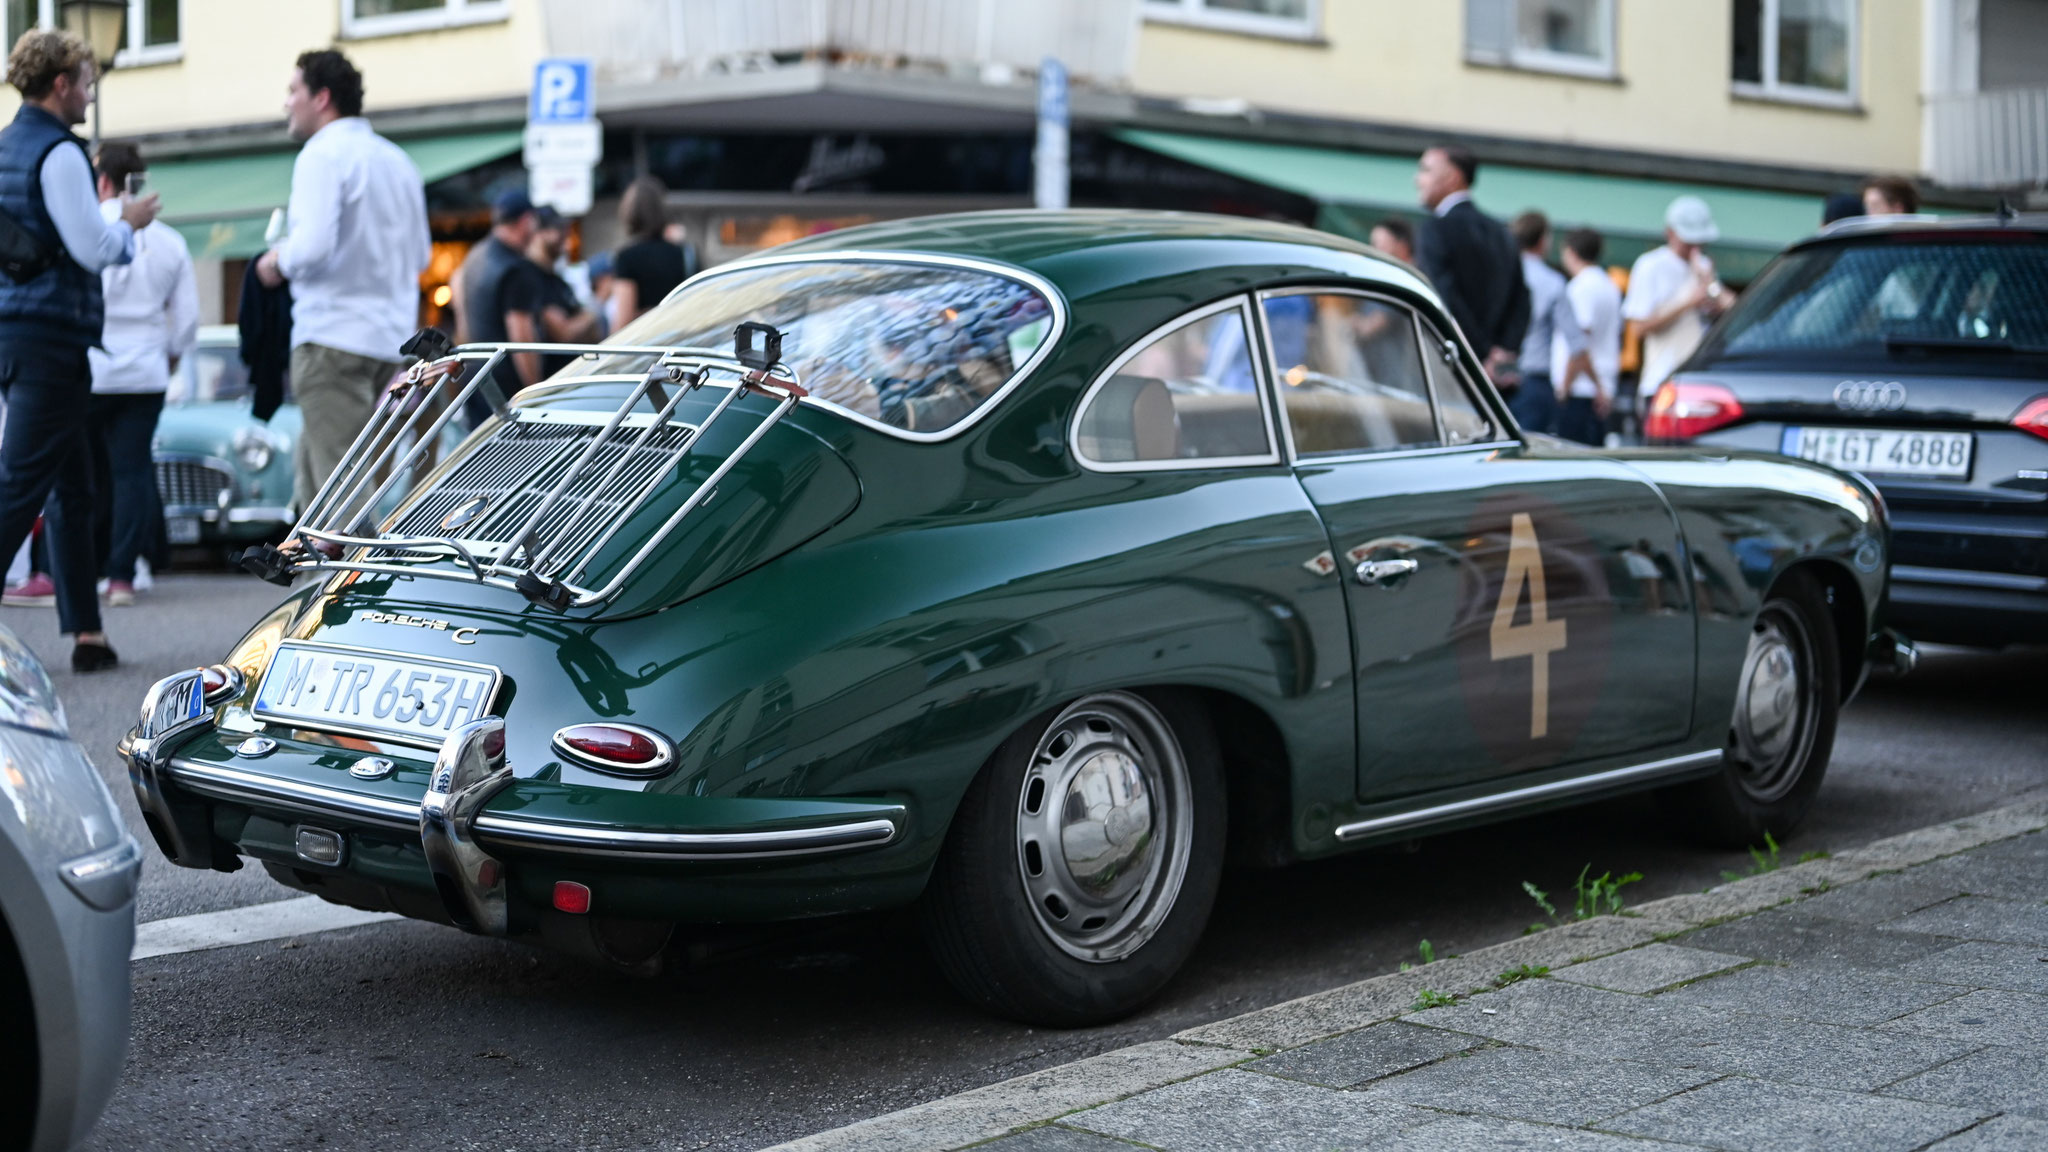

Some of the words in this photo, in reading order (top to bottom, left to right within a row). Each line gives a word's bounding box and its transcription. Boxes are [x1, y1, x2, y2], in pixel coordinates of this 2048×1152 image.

[540, 64, 578, 118] P
[1802, 433, 1820, 462] M
[1841, 436, 1881, 463] GT
[1888, 437, 1965, 467] 4888
[360, 611, 450, 631] PORSCHE
[451, 627, 480, 645] C
[1490, 512, 1567, 739] 4
[276, 656, 314, 707] M
[324, 661, 375, 715] TR
[373, 669, 486, 731] 653H
